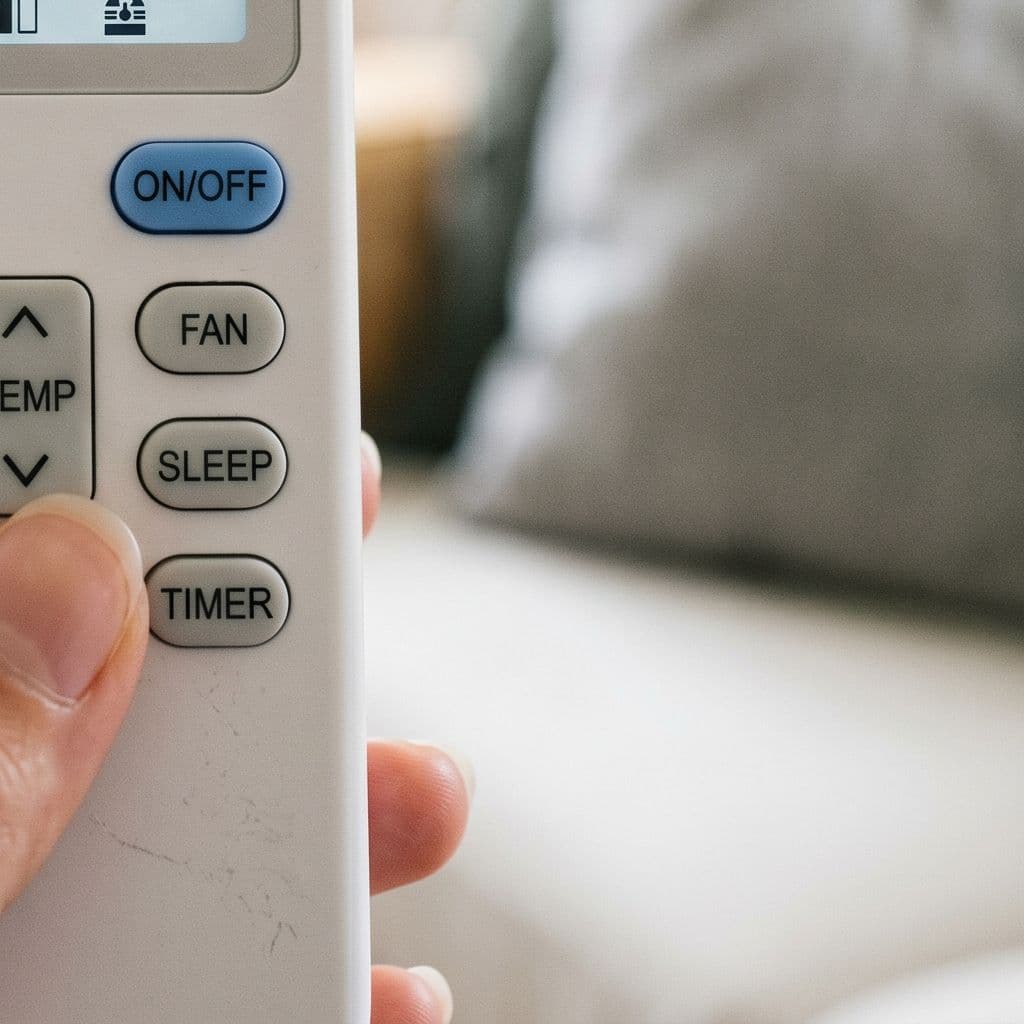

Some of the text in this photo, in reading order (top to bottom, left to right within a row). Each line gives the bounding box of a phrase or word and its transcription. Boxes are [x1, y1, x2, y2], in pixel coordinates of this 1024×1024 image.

[133, 168, 268, 203] ON/OFF
[181, 312, 248, 346] FAN
[158, 449, 273, 482] SLEEP
[161, 586, 274, 621] TIMER
